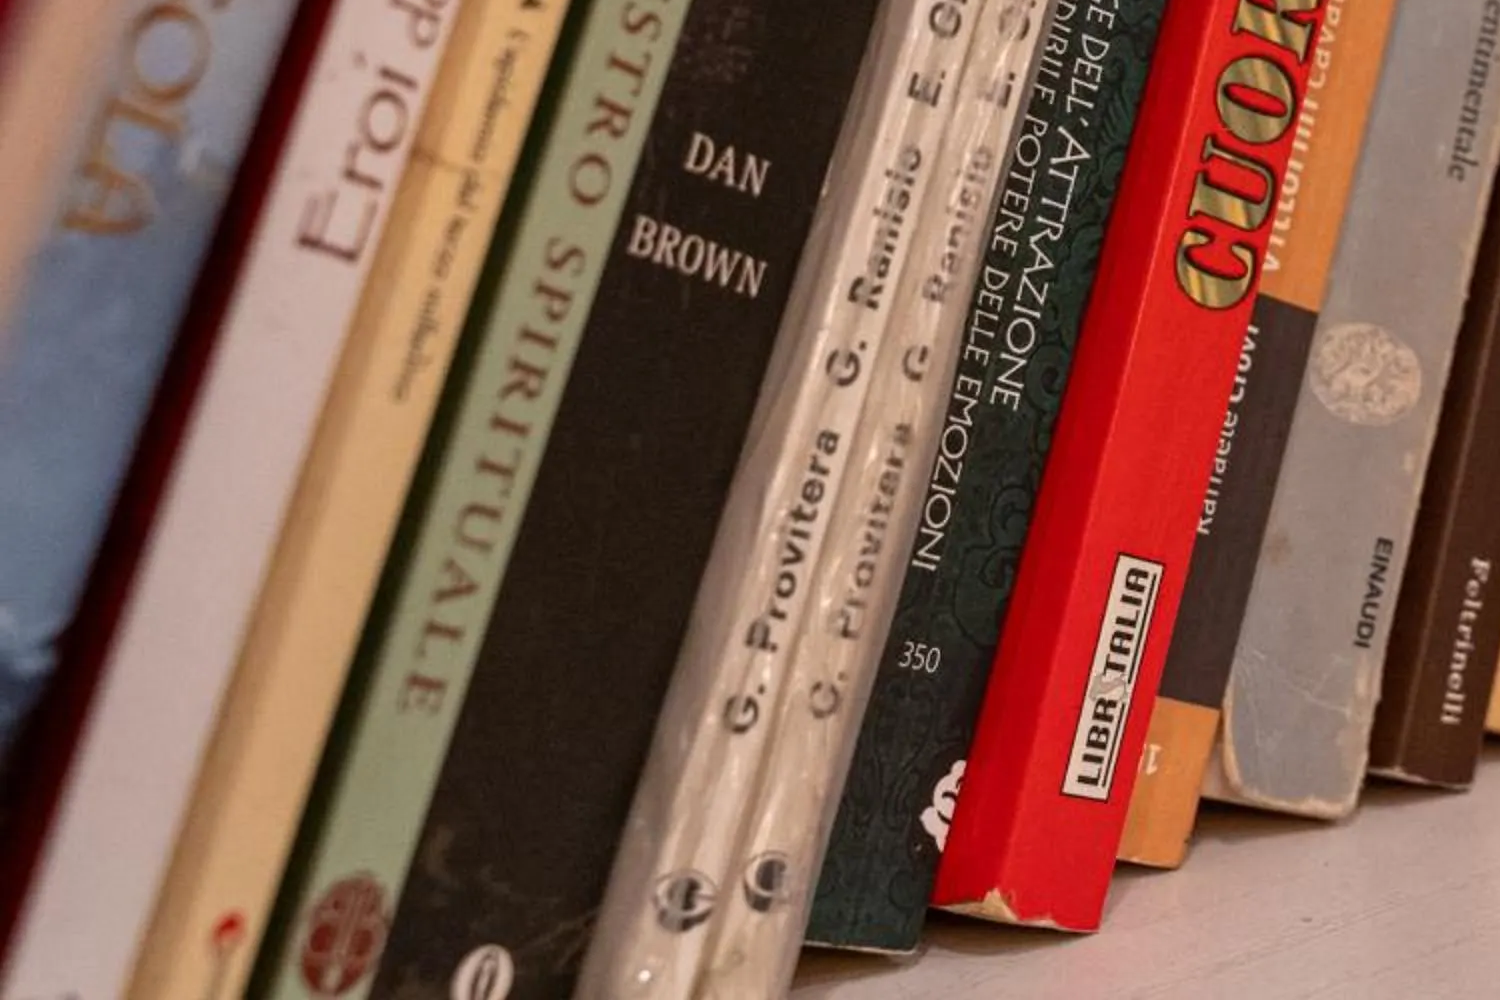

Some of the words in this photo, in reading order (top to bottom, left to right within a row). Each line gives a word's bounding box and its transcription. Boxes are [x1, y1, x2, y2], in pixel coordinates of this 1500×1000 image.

[298, 50, 421, 268] Eroi
[683, 131, 773, 198] DAN
[994, 113, 1049, 259] POTERE
[624, 213, 769, 298] BROWN
[956, 264, 1008, 384] DELLE
[723, 682, 767, 735] G.
[745, 427, 840, 655] Provitera
[826, 340, 867, 388] G.
[848, 147, 923, 314] Ranisio
[907, 69, 947, 109] E.
[399, 236, 586, 716] SPIRITUALE
[911, 390, 980, 573] EMOZIONI
[898, 642, 941, 674] 350
[1351, 538, 1394, 648] EINAUDI
[1440, 556, 1491, 726] Feltrinelli
